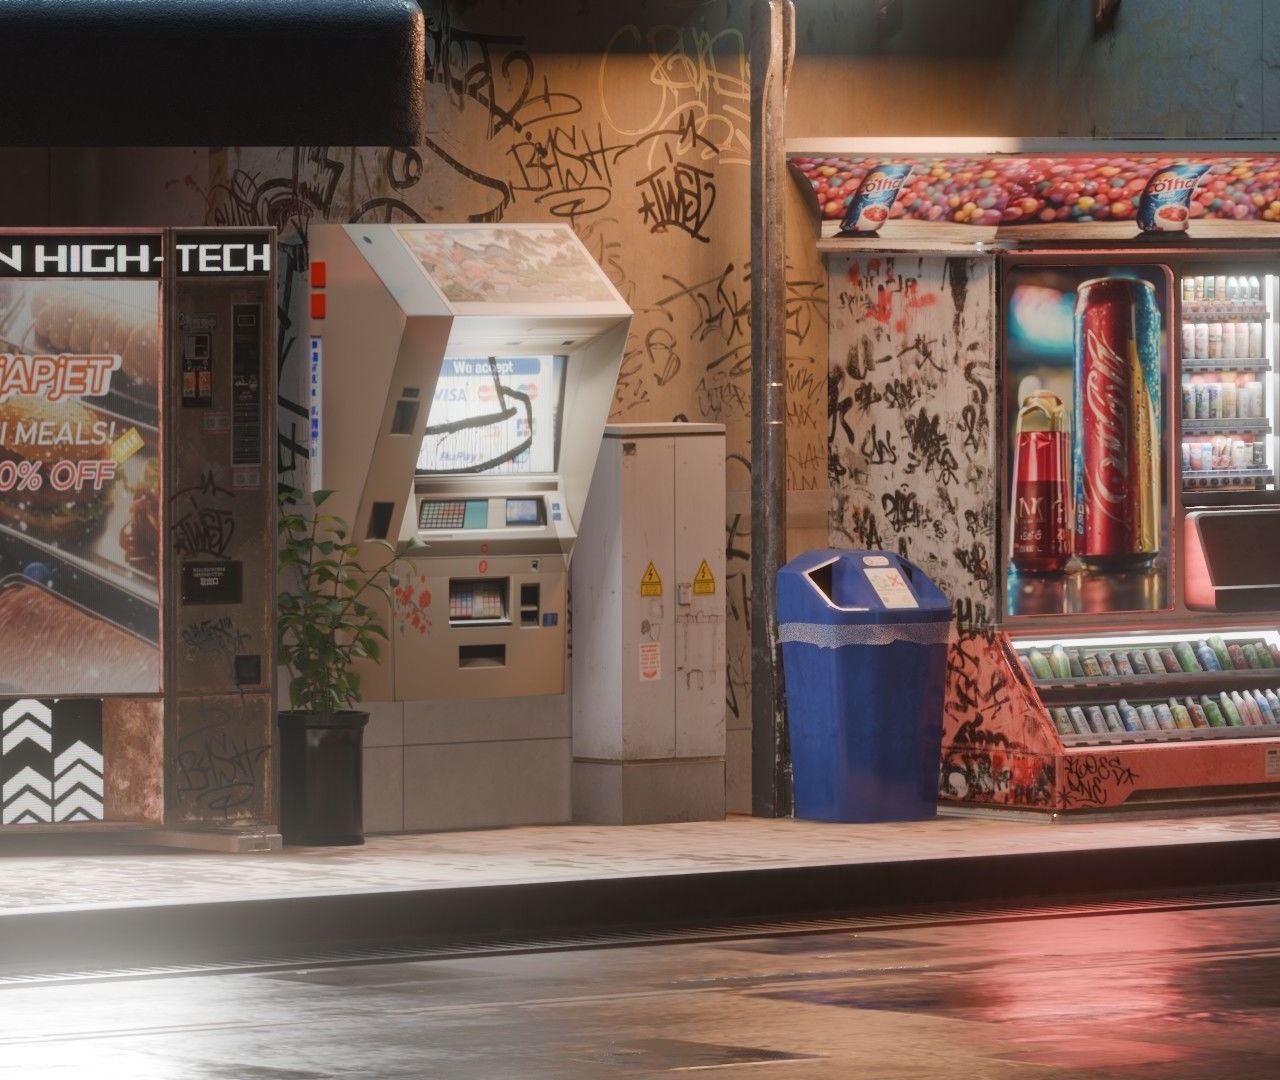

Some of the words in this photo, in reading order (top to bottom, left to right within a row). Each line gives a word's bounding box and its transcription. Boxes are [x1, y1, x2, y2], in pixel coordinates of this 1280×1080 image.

[176, 243, 271, 272] TECH
[474, 361, 514, 375] acept
[14, 421, 116, 446] MEALS!
[50, 460, 118, 492] OFF
